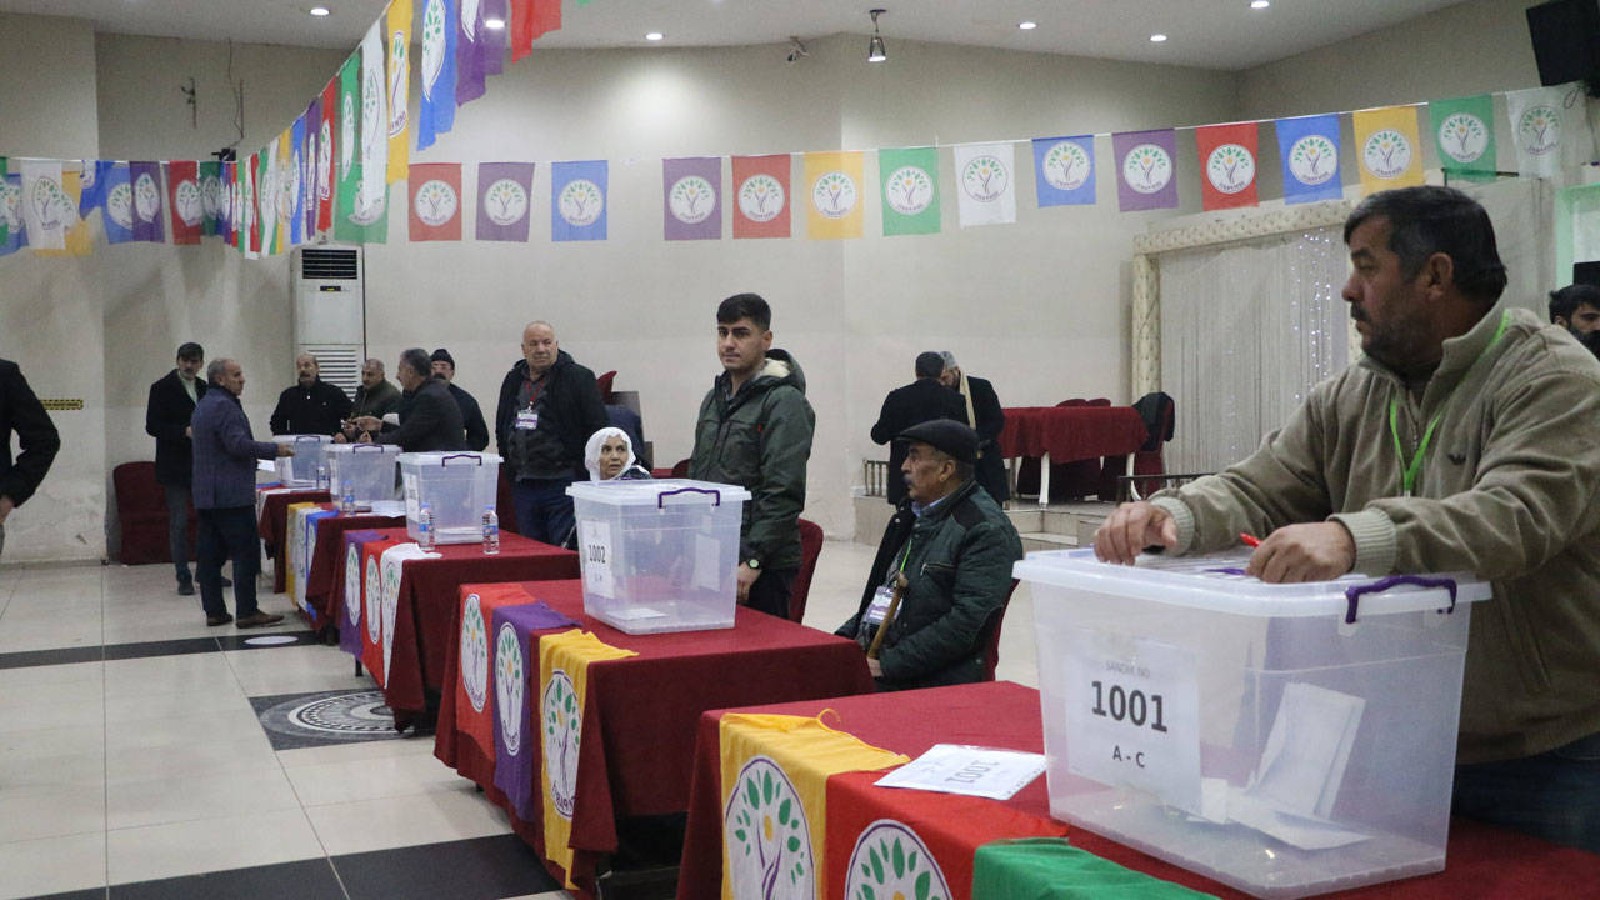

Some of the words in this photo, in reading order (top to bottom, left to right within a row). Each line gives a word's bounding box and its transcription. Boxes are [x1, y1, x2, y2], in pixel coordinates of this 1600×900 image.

[1091, 680, 1168, 732] 1001
[1112, 745, 1123, 762] A
[1135, 751, 1146, 768] C
[945, 760, 1000, 783] 1001
